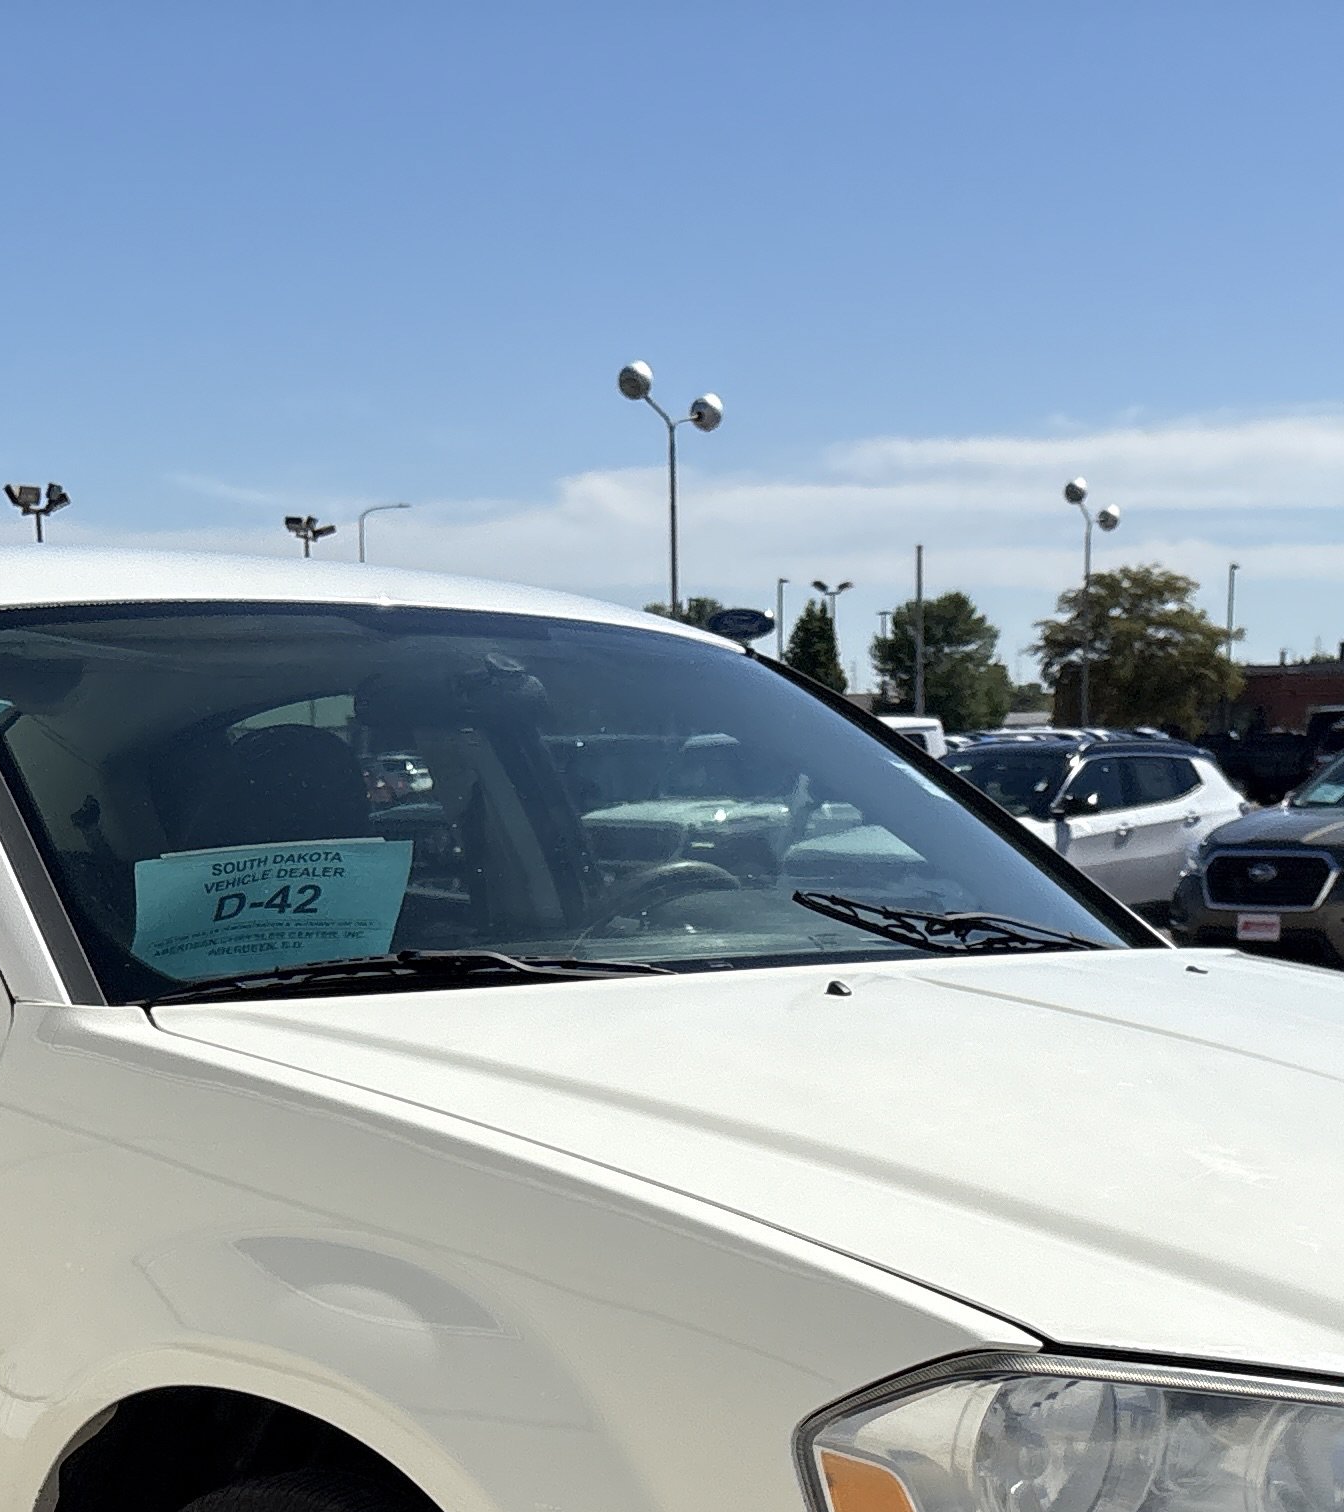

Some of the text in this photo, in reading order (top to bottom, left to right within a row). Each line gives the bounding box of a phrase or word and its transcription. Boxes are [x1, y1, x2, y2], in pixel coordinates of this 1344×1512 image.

[212, 852, 343, 876] SOUTH DAKOTA
[204, 867, 345, 894] VEHICLE DEALER
[213, 884, 322, 922] D-42
